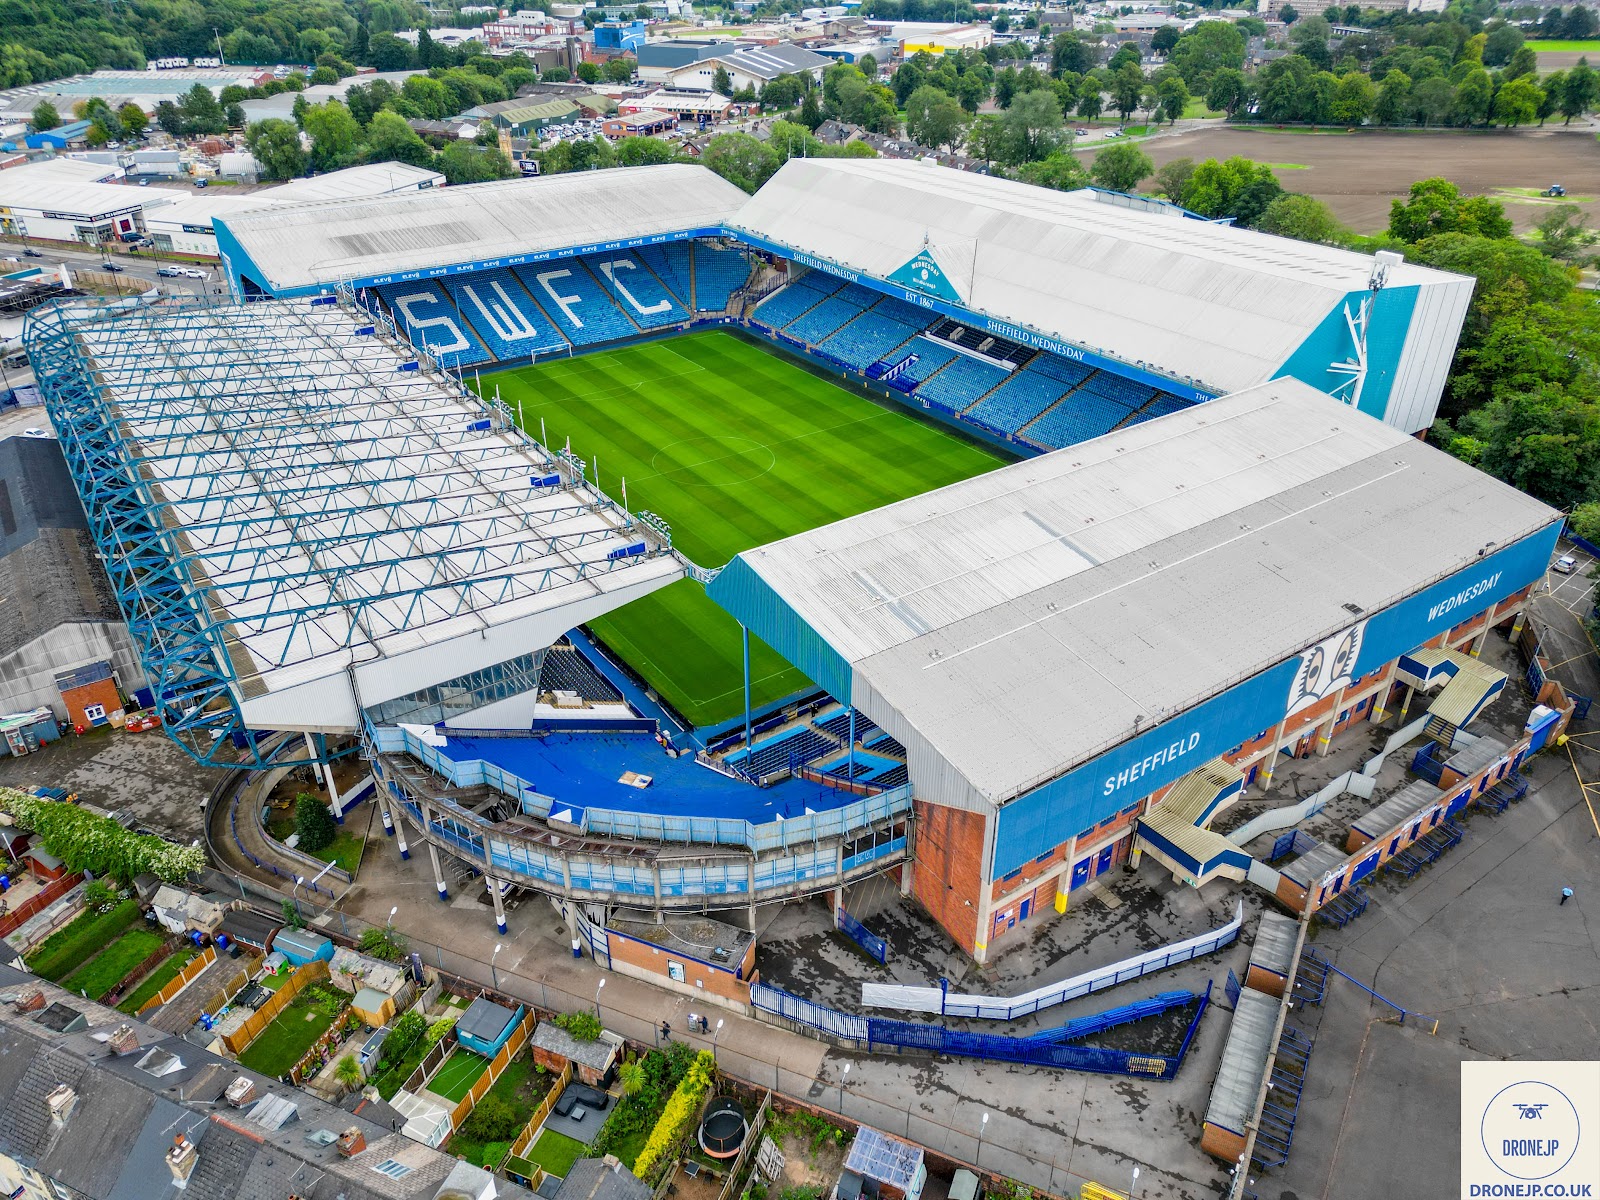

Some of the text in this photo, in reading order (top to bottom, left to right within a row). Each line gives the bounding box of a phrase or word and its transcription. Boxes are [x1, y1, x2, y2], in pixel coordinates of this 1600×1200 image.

[793, 252, 860, 282] SHEFFIELD WEDNESDAY
[911, 261, 940, 277] WEDNESDAY
[905, 291, 934, 309] EST. 1867
[986, 320, 1085, 361] SHEFFIELD WEDNESDAY
[1103, 570, 1503, 796] SHEFFIELD WEDNESDAY
